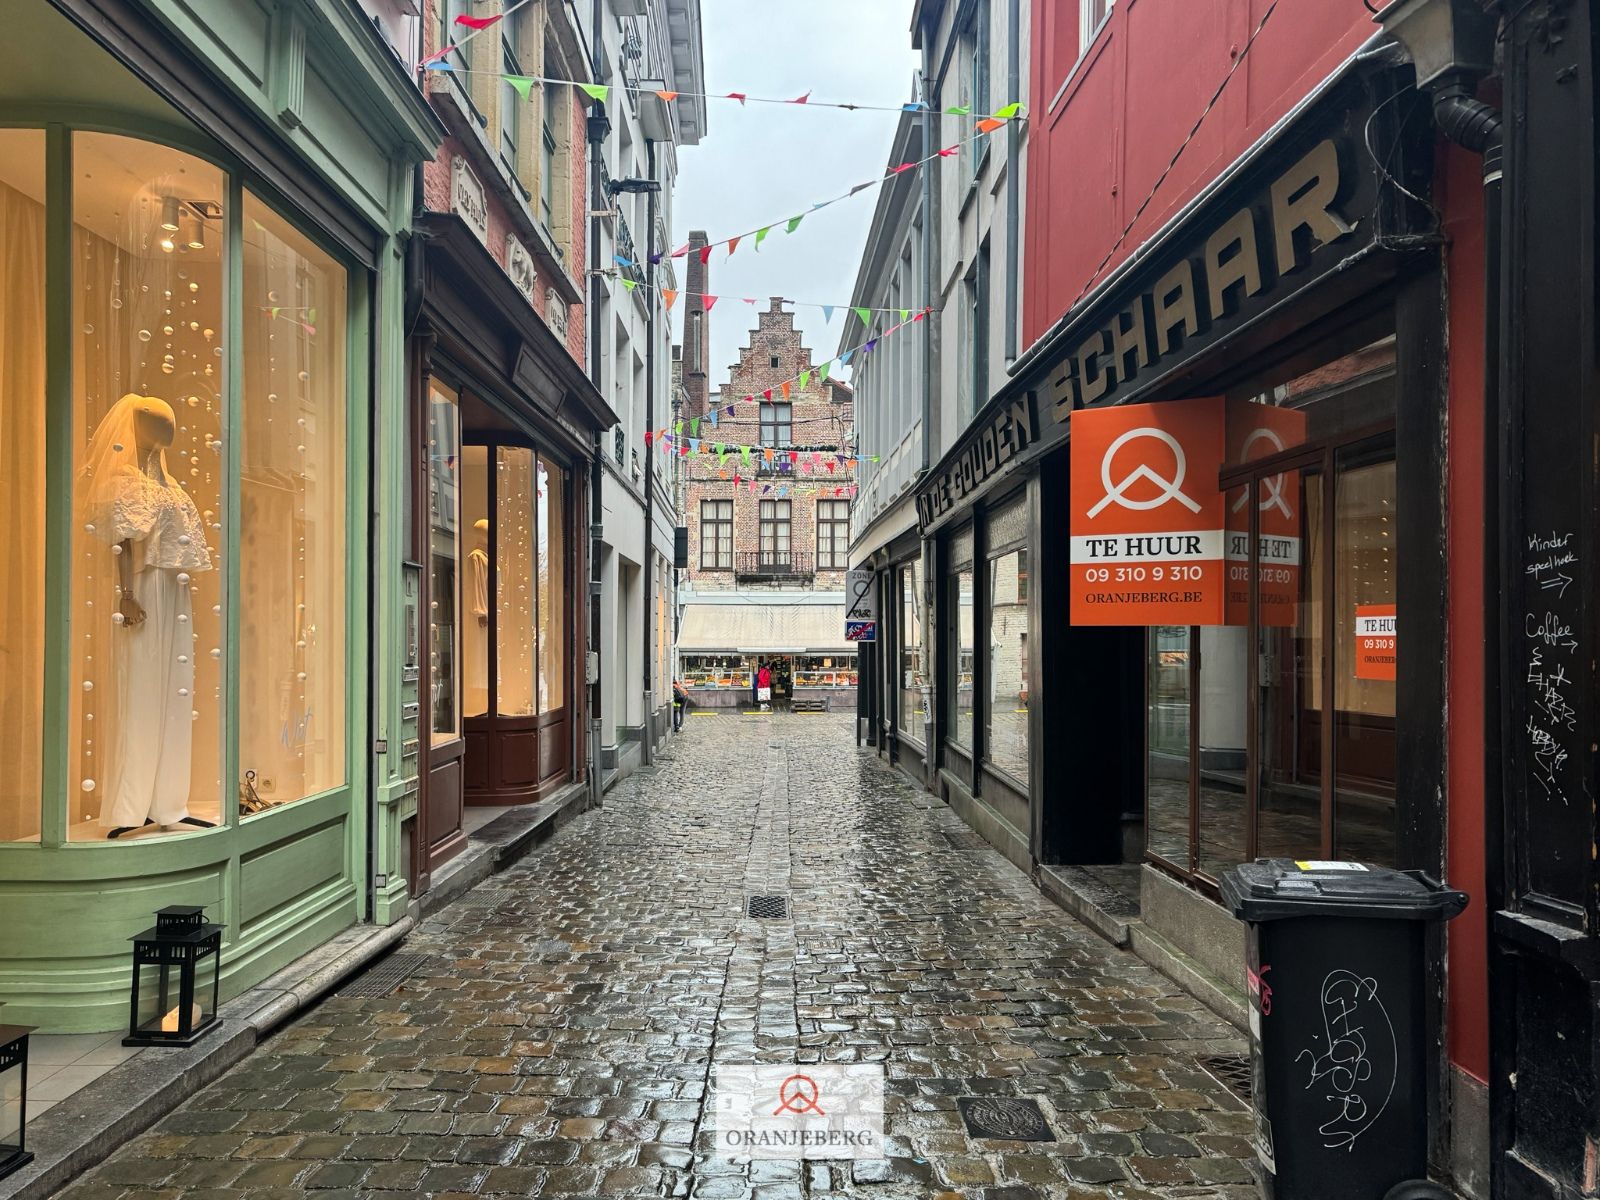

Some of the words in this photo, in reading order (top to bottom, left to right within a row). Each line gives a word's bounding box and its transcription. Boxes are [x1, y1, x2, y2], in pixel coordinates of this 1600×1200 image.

[918, 494, 931, 528] IN
[932, 477, 949, 517] DE
[952, 392, 1032, 500] GOUDEN
[1046, 139, 1358, 424] SCHAAR
[1086, 538, 1118, 557] TE
[1125, 535, 1203, 556] HUUR
[1528, 530, 1574, 552] Kinder
[852, 572, 873, 580] ZONE
[1085, 568, 1109, 582] 09
[1115, 567, 1146, 581] 310
[1152, 567, 1164, 581] 9
[1170, 566, 1203, 581] 310
[1085, 591, 1203, 604] ORANJEBERG.BE
[1364, 619, 1377, 632] TE
[1525, 611, 1574, 647] Coffee
[1364, 639, 1374, 649] 09
[1375, 639, 1388, 649] 310
[1388, 639, 1395, 649] 9
